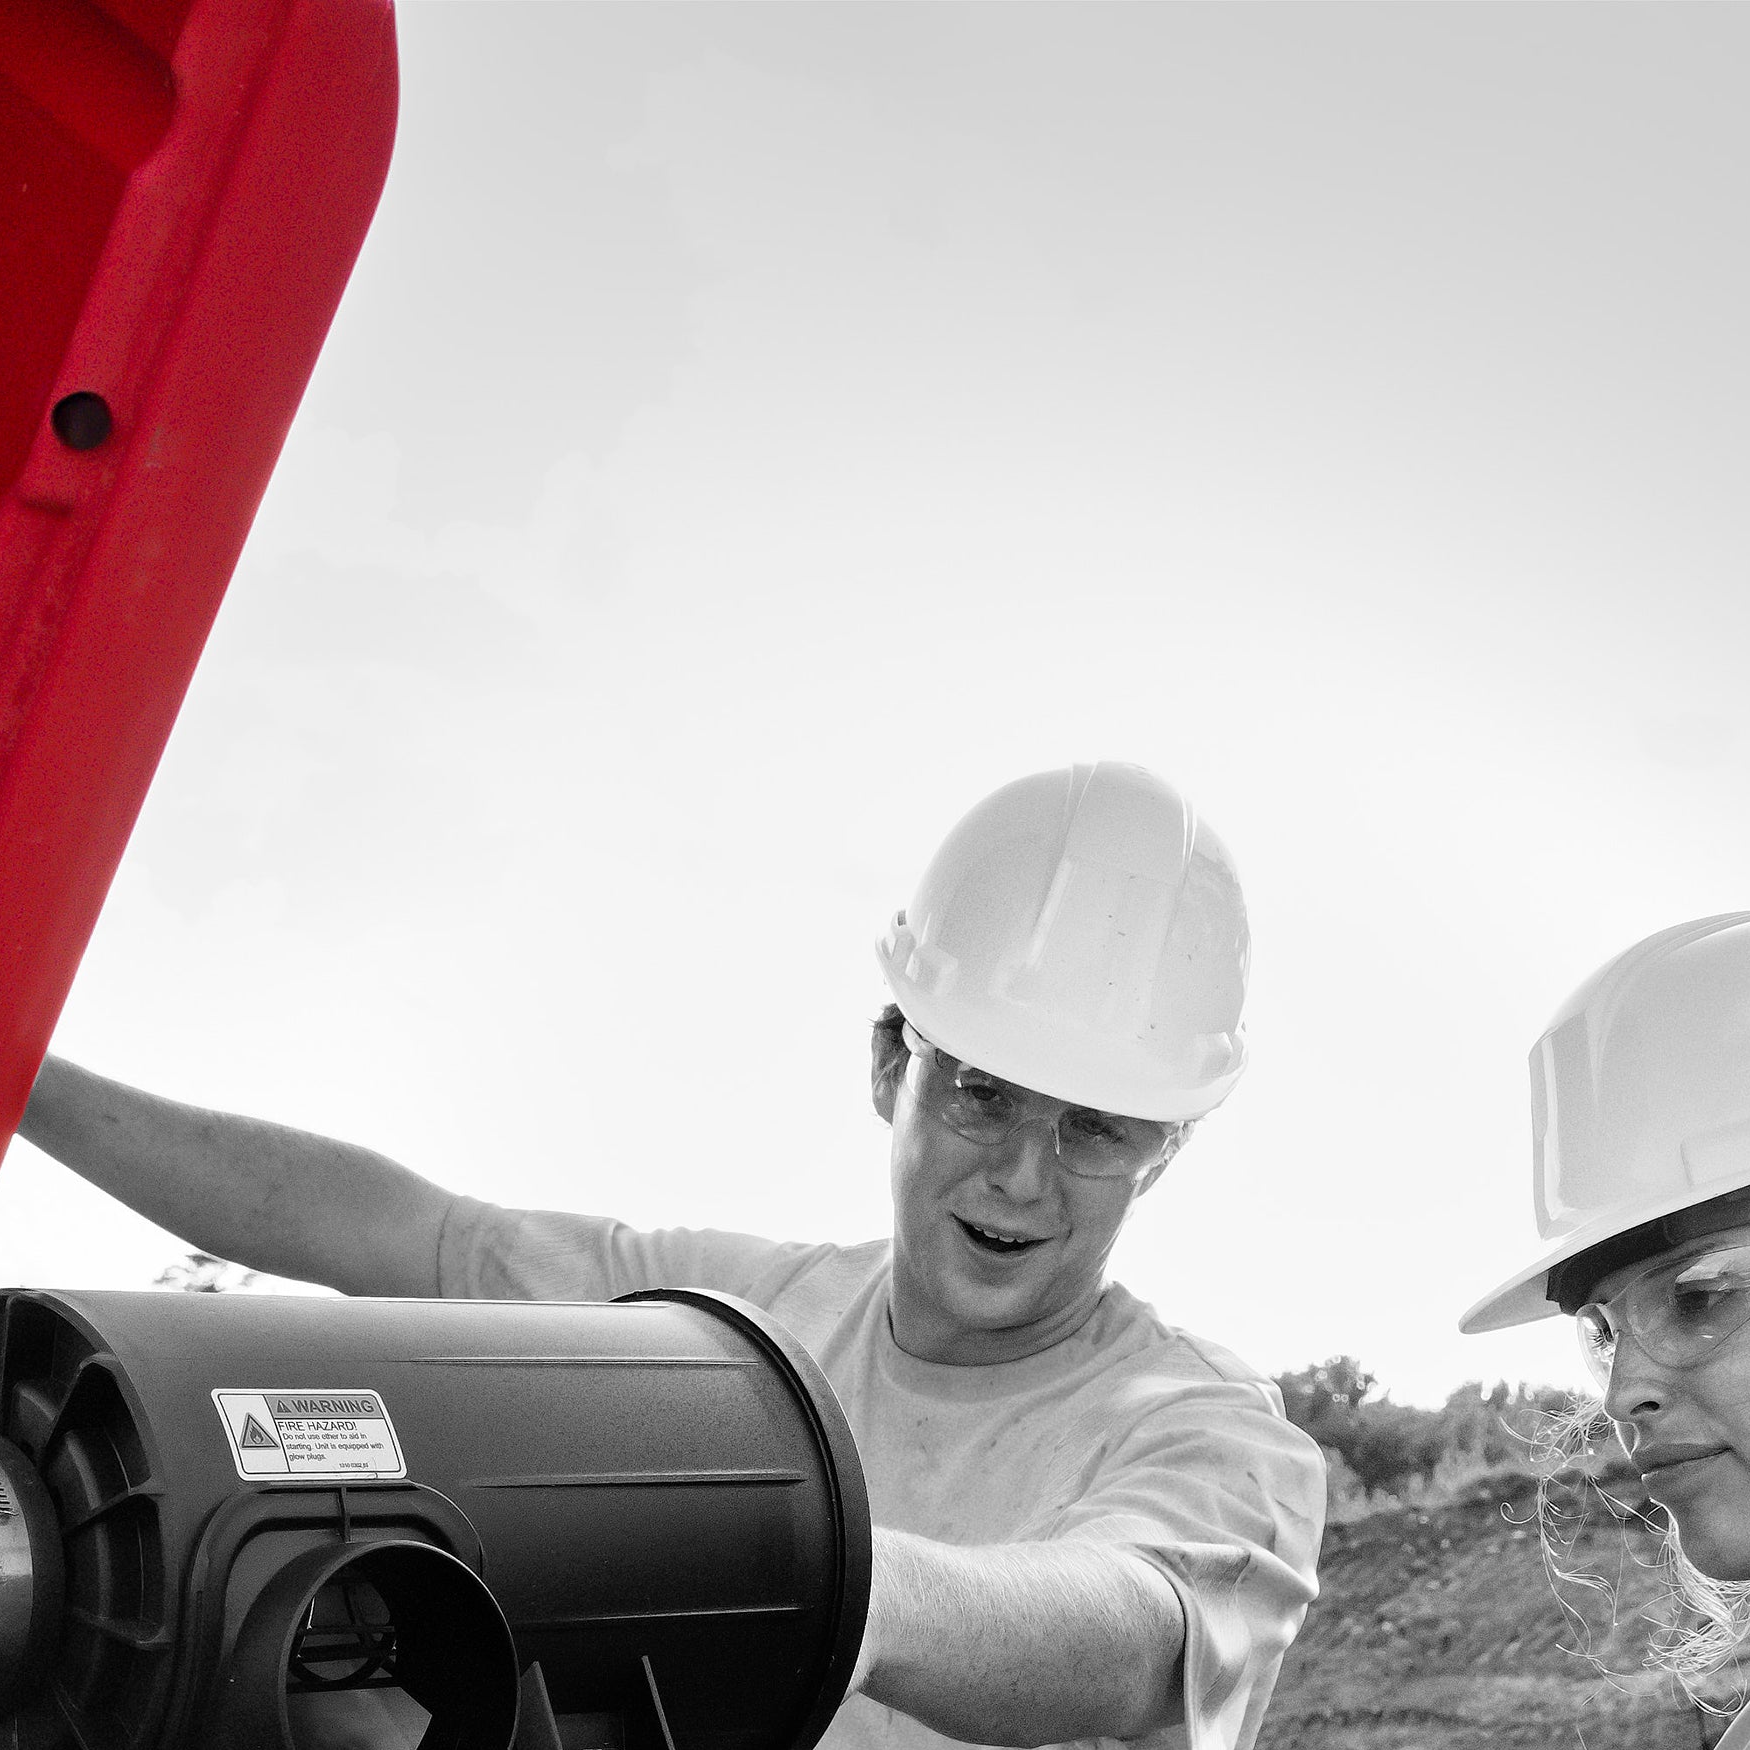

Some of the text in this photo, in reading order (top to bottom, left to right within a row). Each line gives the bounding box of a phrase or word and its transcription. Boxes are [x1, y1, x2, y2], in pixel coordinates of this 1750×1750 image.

[291, 1399, 375, 1413] WARNING
[278, 1421, 358, 1431] FIRE HAZARD!
[315, 1442, 330, 1450] Unit
[330, 1442, 337, 1450] is
[338, 1442, 369, 1451] equipped
[370, 1442, 385, 1450] with
[289, 1453, 327, 1461] glow plugs.
